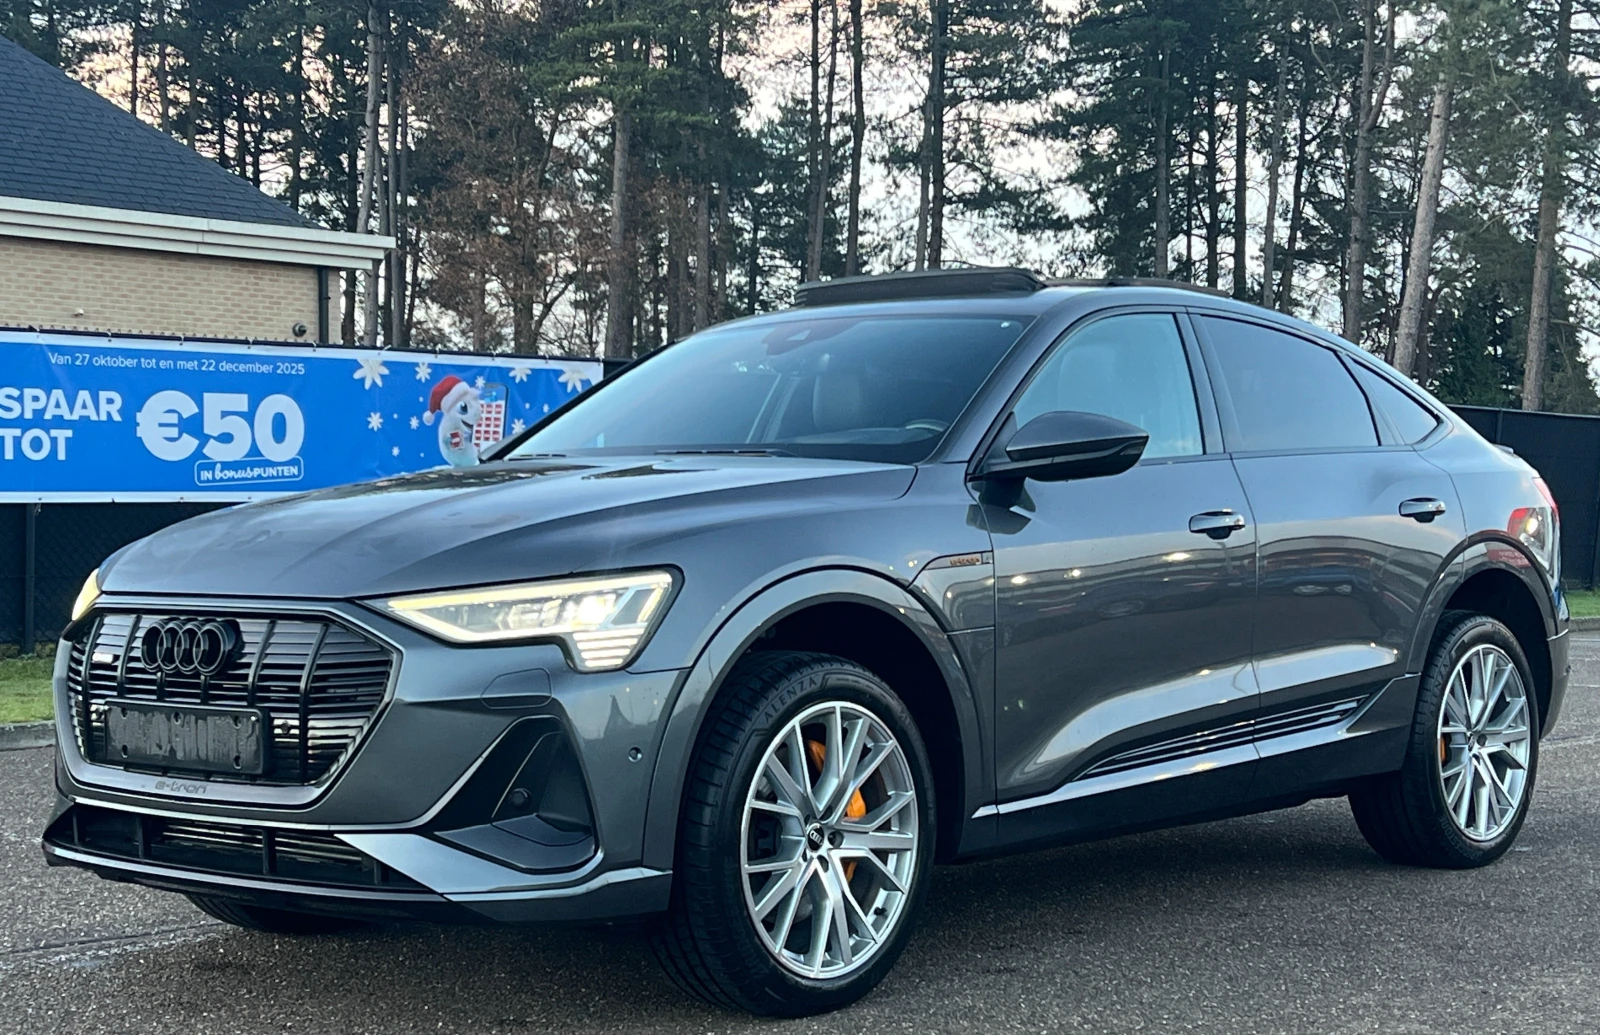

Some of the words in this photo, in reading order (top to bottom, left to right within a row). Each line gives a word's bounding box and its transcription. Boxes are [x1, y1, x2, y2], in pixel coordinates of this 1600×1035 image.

[48, 352, 72, 365] Van
[74, 353, 90, 366] 27
[92, 354, 138, 368] oktober
[141, 357, 157, 369] tot
[159, 360, 174, 370] en
[177, 360, 199, 371] met
[201, 359, 216, 371] 22
[218, 360, 274, 374] december
[276, 362, 305, 375] 2025
[0, 386, 122, 422] SPAAR
[136, 390, 305, 462] €50
[0, 428, 73, 461] TOT
[200, 470, 213, 481] IN
[764, 676, 817, 724] ALENZA
[155, 780, 207, 794] e-tron
